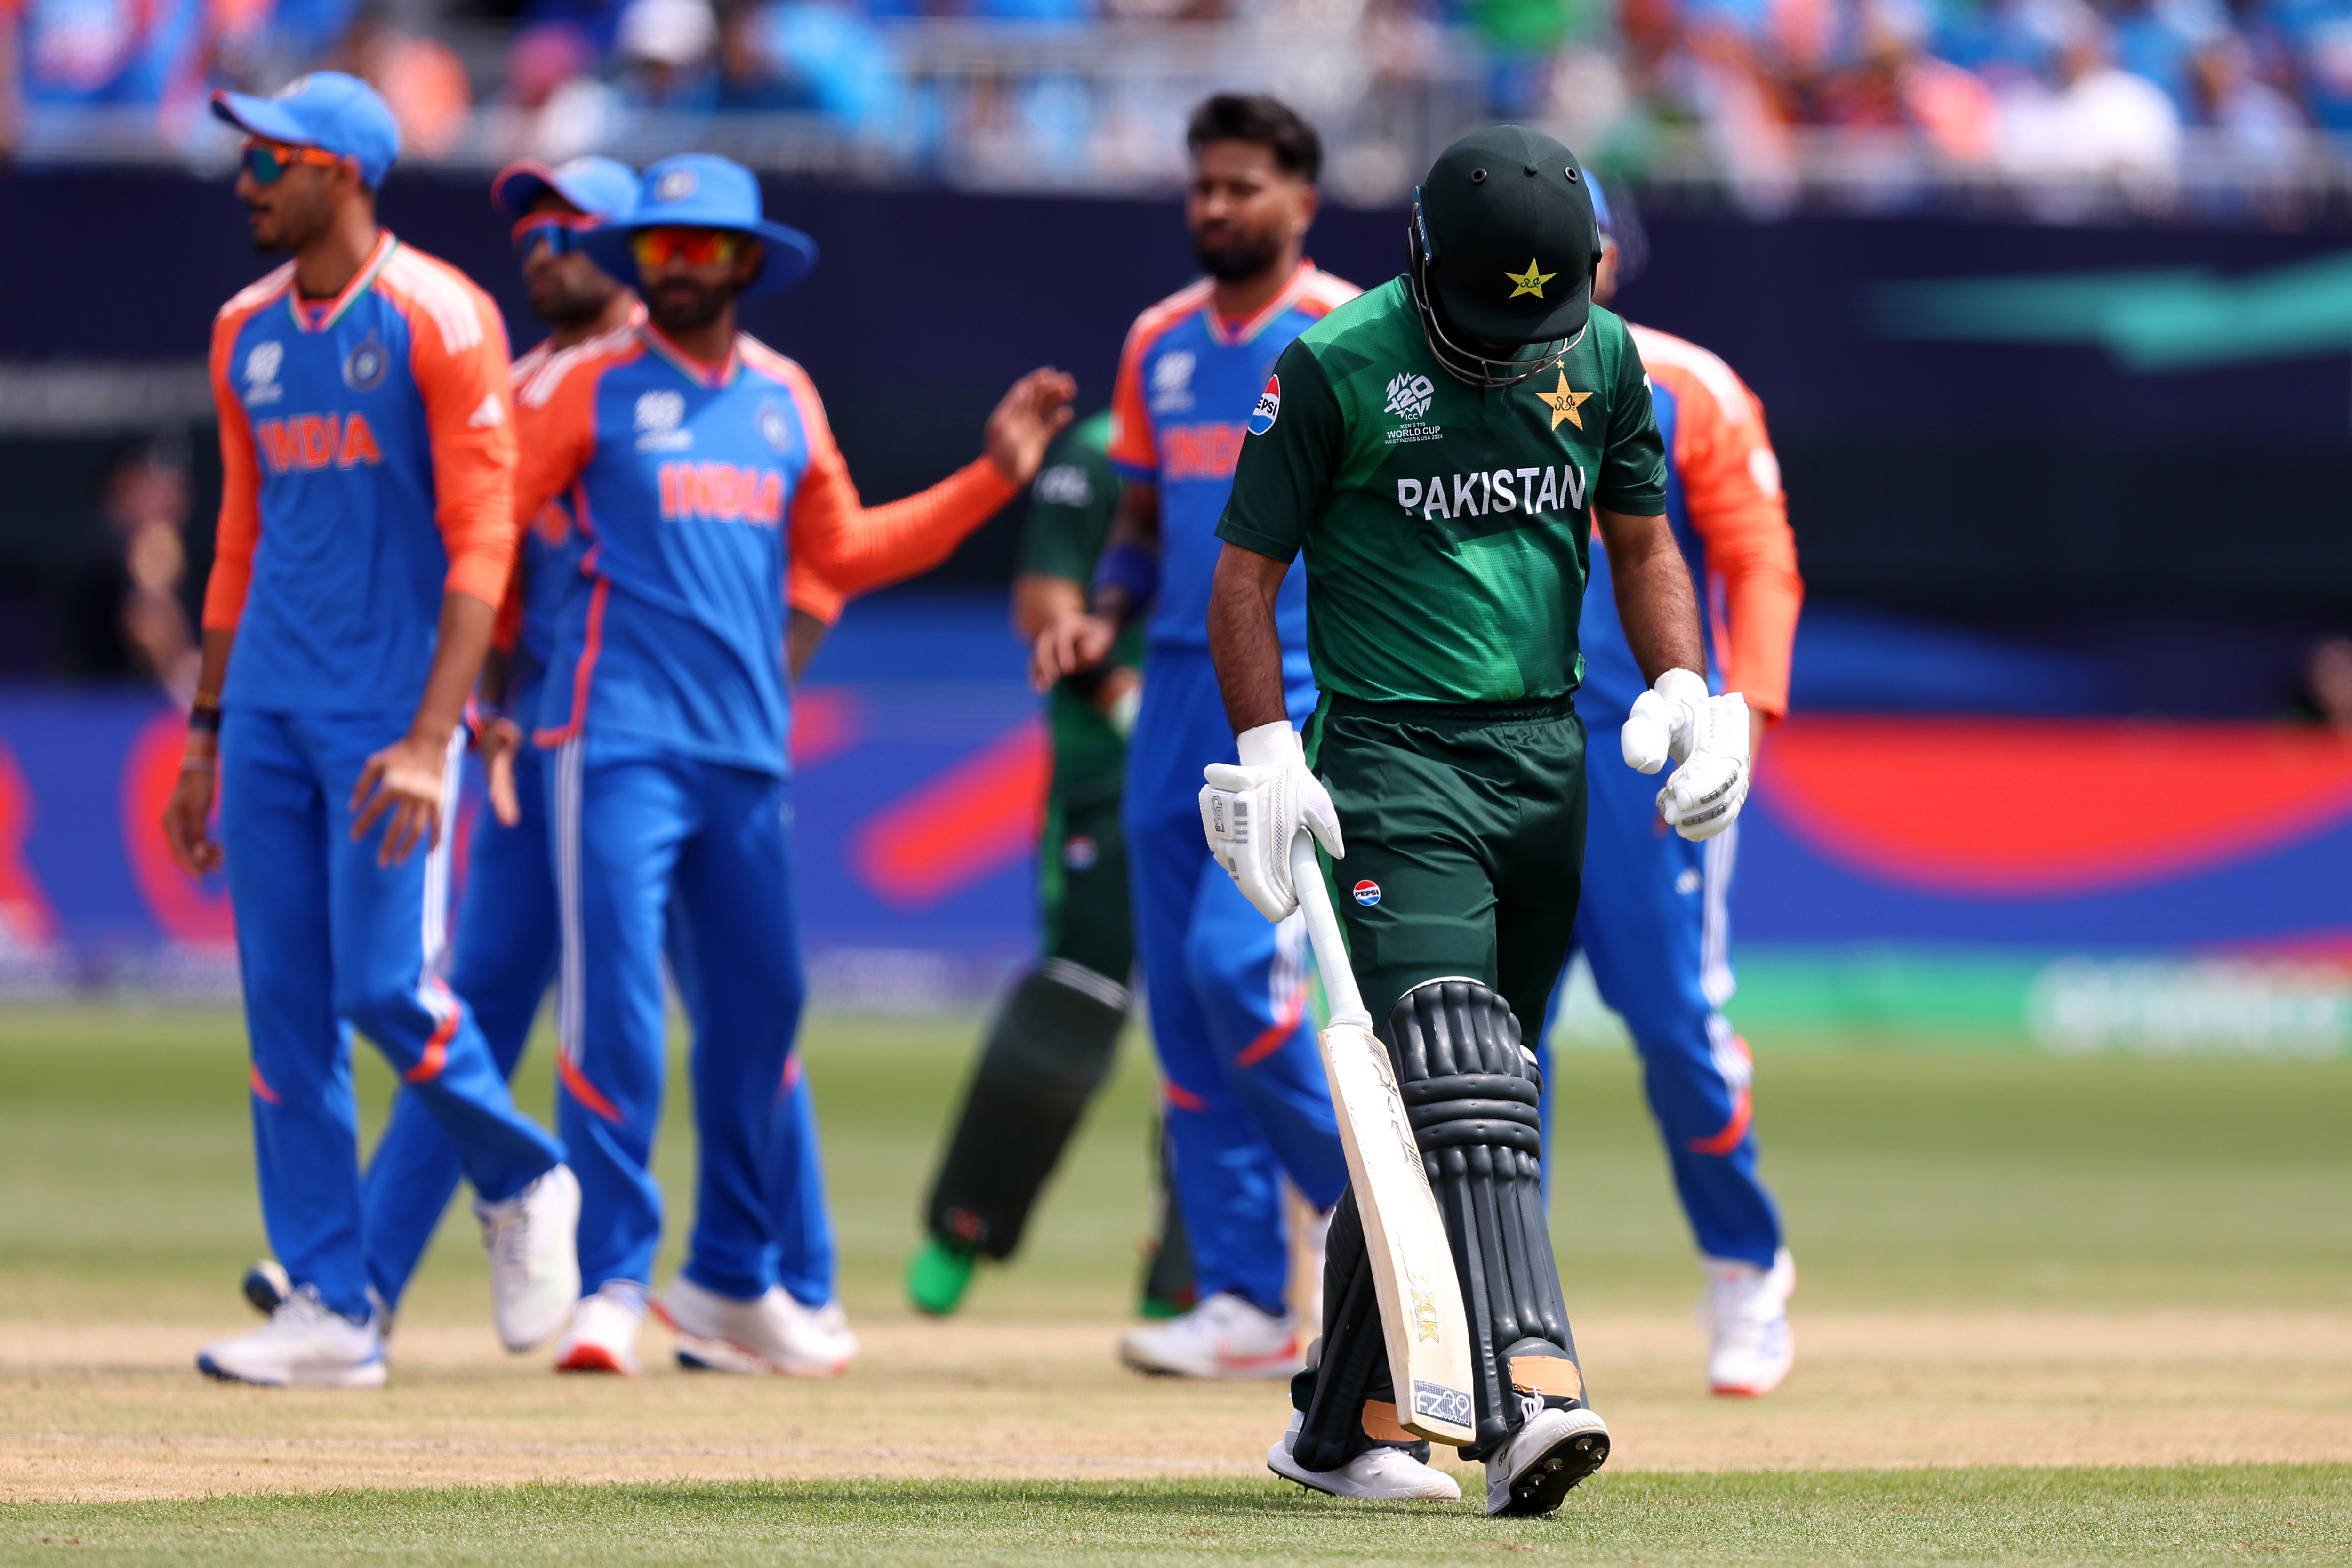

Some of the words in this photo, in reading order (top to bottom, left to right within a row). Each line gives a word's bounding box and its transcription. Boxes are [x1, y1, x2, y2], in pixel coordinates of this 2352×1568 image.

[1256, 396, 1278, 416] EPSI
[1387, 428, 1421, 439] WORLD
[1422, 426, 1440, 434] CUP
[257, 410, 383, 476] INDIA
[659, 460, 784, 530] INDIA
[1398, 465, 1585, 521] PAKISTAN
[1355, 889, 1379, 897] PEPSI
[1410, 1286, 1439, 1344] 20K
